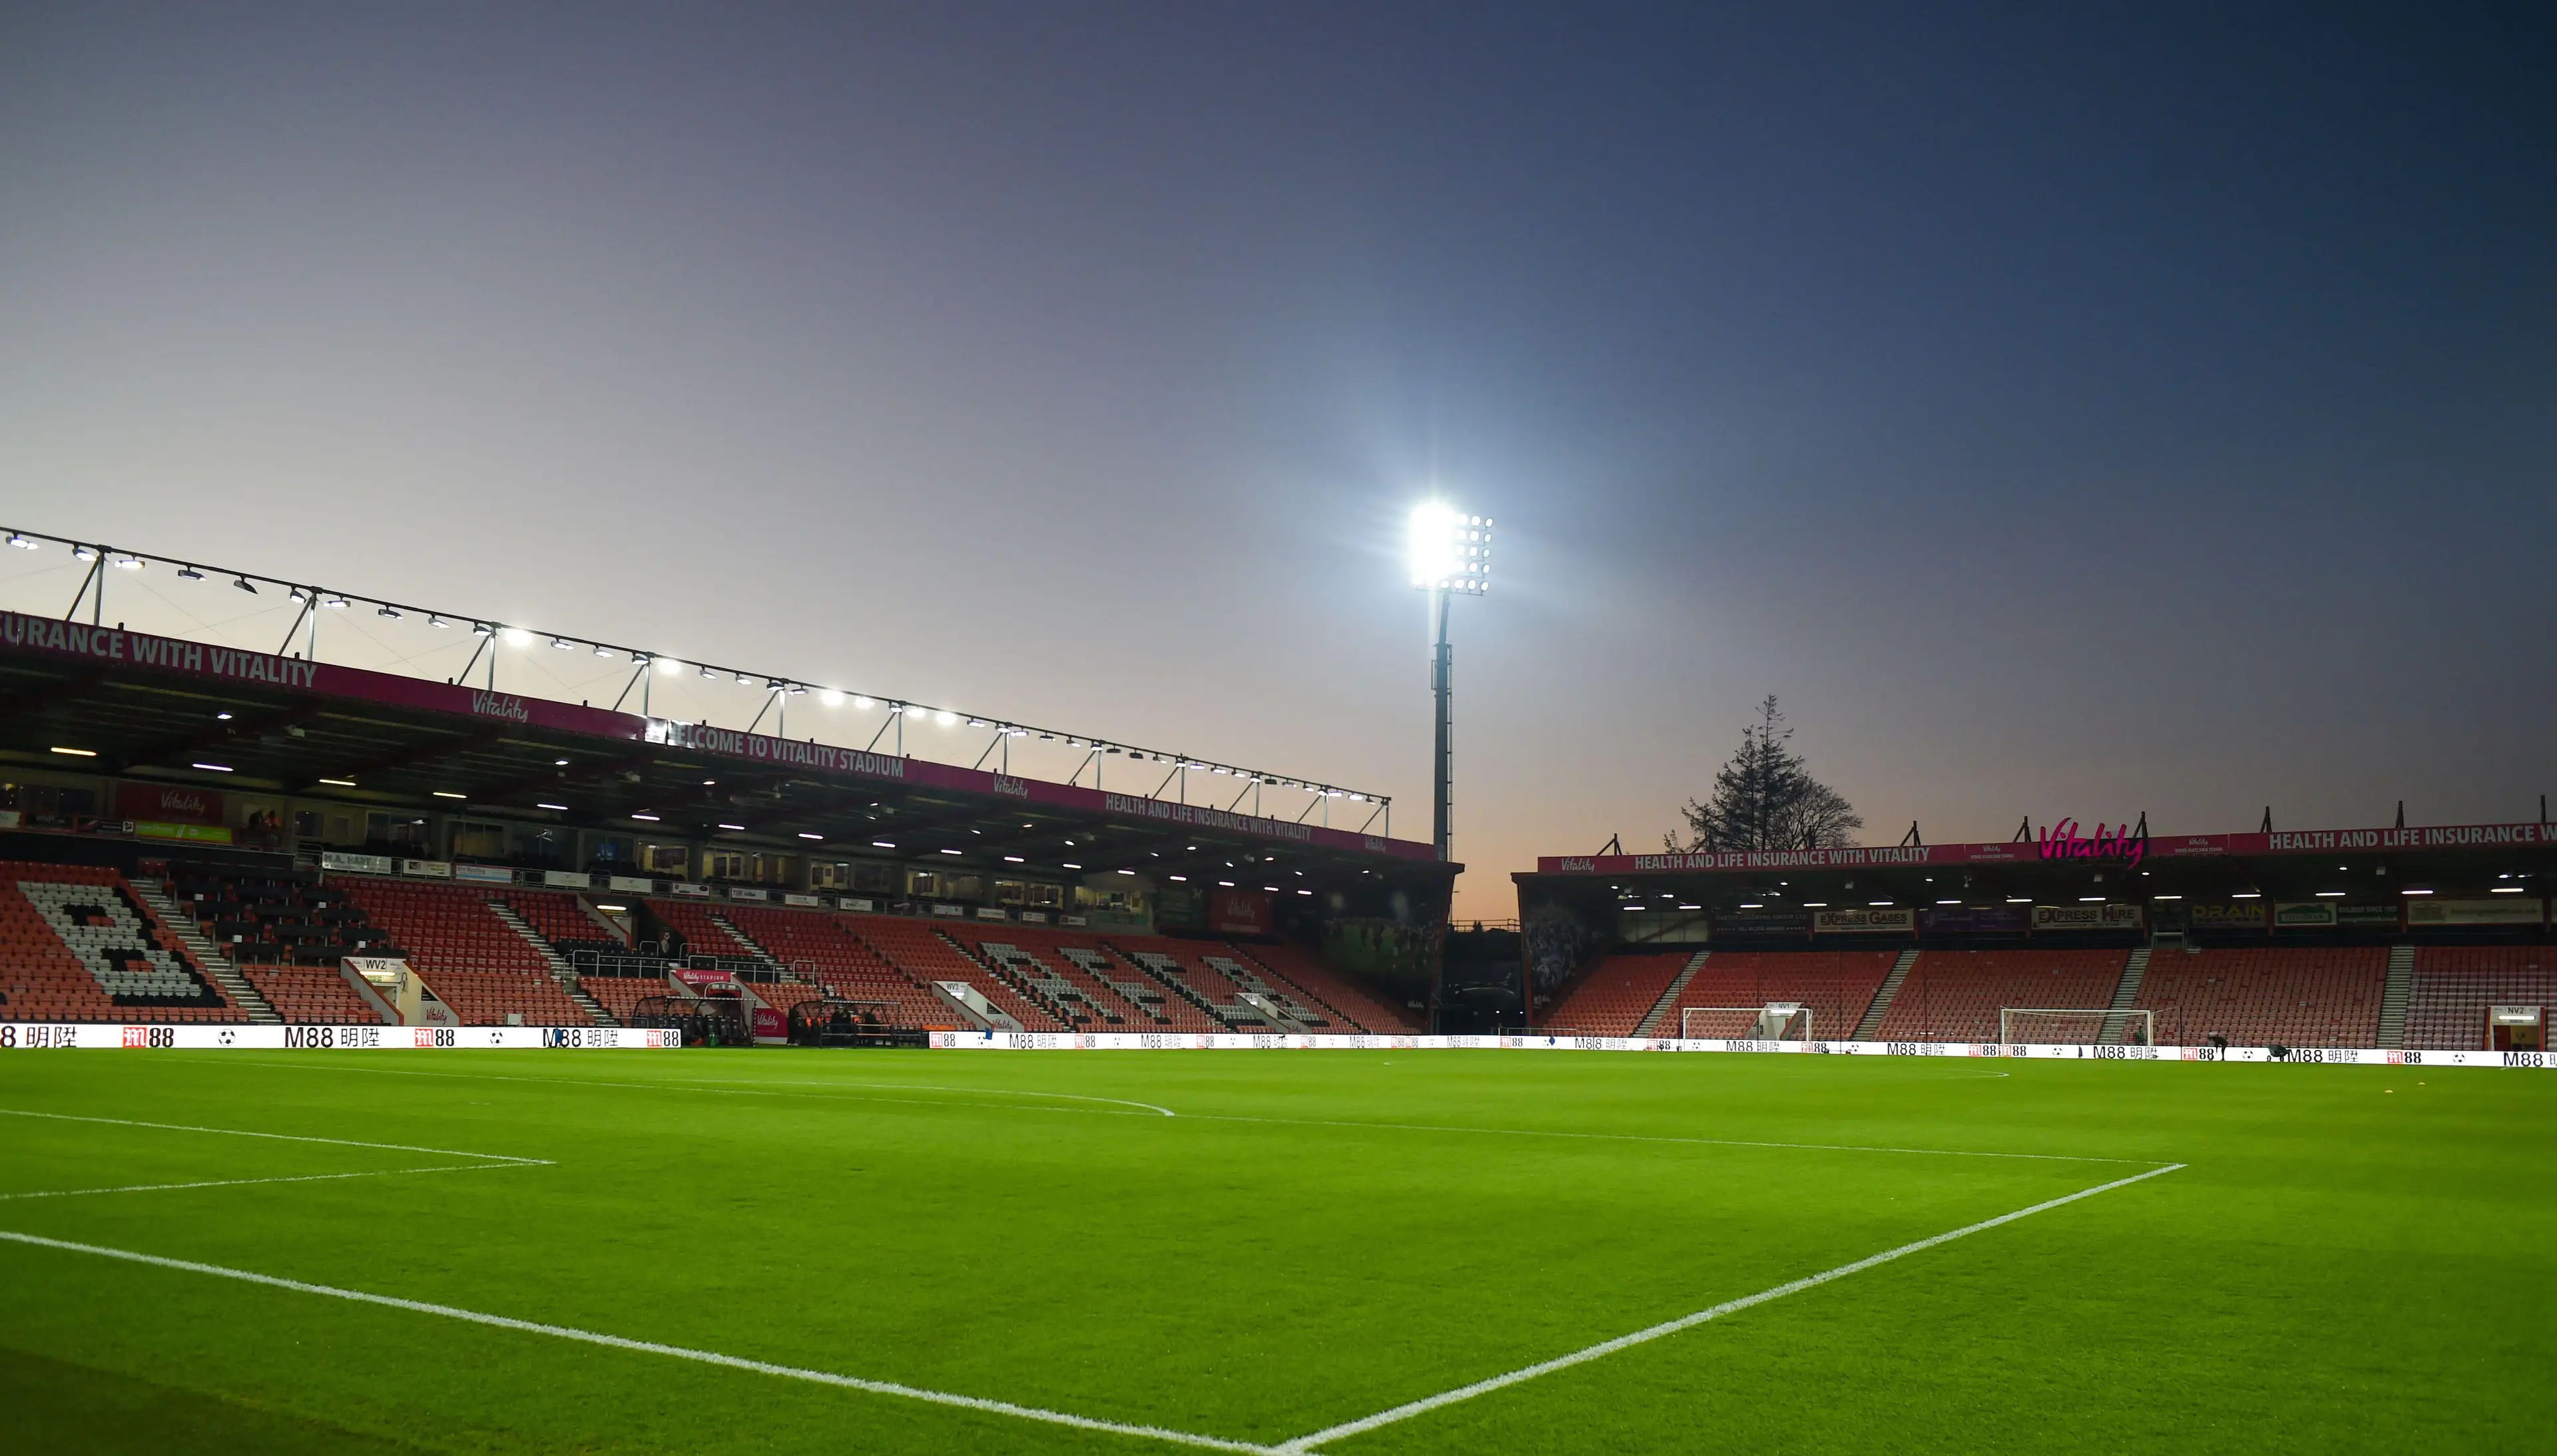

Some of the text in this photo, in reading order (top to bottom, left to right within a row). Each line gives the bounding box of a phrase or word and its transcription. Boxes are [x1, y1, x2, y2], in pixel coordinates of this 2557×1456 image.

[133, 635, 201, 671] WITH
[210, 648, 317, 688] VITALITY
[472, 690, 529, 722] Vitality
[673, 722, 904, 778] ELCOME TO VITALITY STADIUM
[994, 774, 1027, 798] Vitality
[161, 791, 206, 817] Vitality
[1106, 794, 1311, 841] HEALTH AND LIFE INSURANCE WITH VITALITY
[2040, 817, 2142, 869] Vitality
[2270, 832, 2334, 849] HEALTH
[2339, 830, 2379, 848] AND
[2384, 828, 2419, 846] LIFE
[2426, 826, 2534, 845] INSURANCE
[1562, 856, 1595, 872] Vitality
[1635, 847, 1930, 870] HEALTH AND LIFE INSURANCE WITH VITALITY
[1821, 911, 1906, 925] EXPRESS GASES
[2039, 907, 2135, 922] EXPRESS HIRE
[366, 959, 386, 970] WV2
[683, 971, 699, 981] Vitality
[426, 1007, 447, 1025] Vitality
[757, 1013, 778, 1030] Vitality
[993, 1017, 1013, 1032] Vitality
[285, 1027, 333, 1048] M88
[1009, 1034, 1033, 1049] M88
[1141, 1035, 1162, 1048] M88
[1253, 1035, 1271, 1048] M88
[1350, 1036, 1365, 1048] M88
[1575, 1038, 1601, 1049] M88
[1727, 1041, 1753, 1052] M88
[1888, 1043, 1916, 1055] M88
[2094, 1046, 2126, 1059] M88
[2288, 1049, 2323, 1062] M88
[2504, 1052, 2543, 1067] M88
